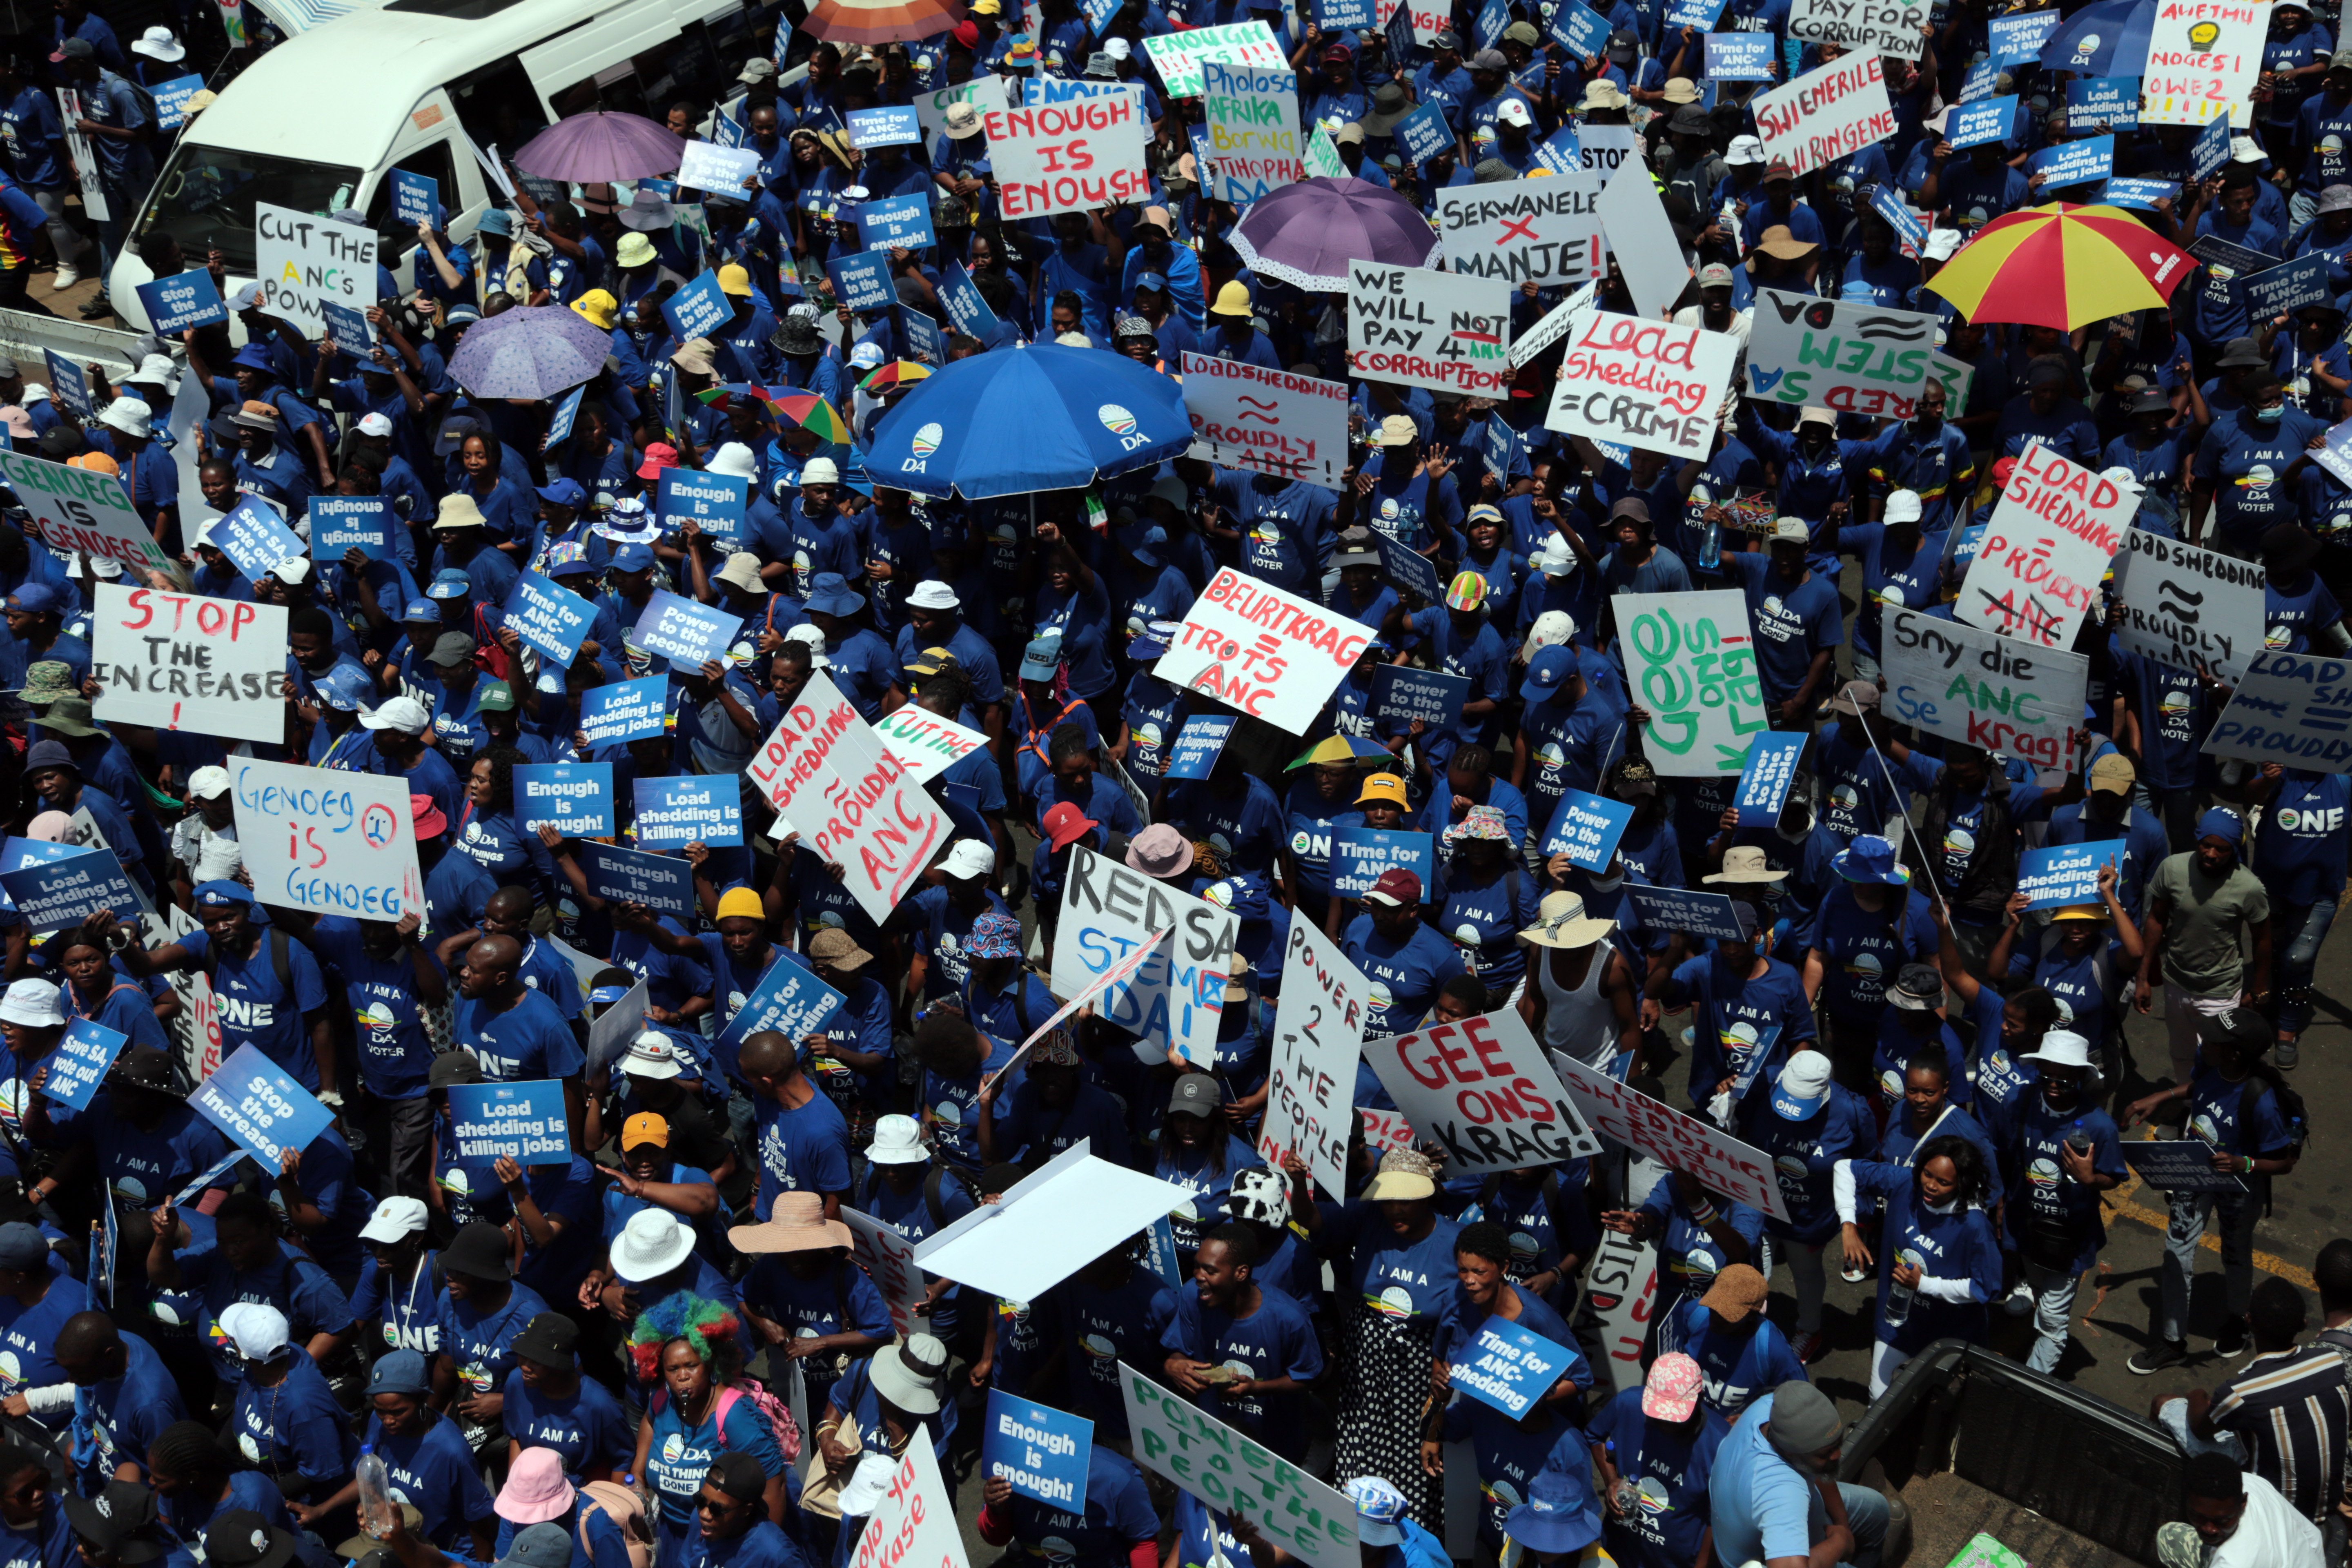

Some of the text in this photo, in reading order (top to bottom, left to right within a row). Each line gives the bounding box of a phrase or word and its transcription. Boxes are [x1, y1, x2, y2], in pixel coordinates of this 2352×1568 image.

[1147, 22, 1268, 55] ENOUGH
[2070, 54, 2089, 65] DA
[852, 113, 909, 127] Time for
[984, 99, 1131, 141] ENOUGH
[1207, 96, 1283, 127] AFRIKA
[1958, 118, 1998, 134] to the
[1960, 107, 2002, 125] Power
[854, 130, 916, 146] shedding
[866, 122, 901, 134] ANC-
[1951, 127, 2002, 148] people!
[699, 152, 742, 170] Power
[1036, 139, 1094, 172] IS
[689, 175, 742, 193] people!
[696, 165, 738, 181] to the
[1001, 168, 1149, 216] ENOUGH
[1443, 191, 1600, 230] SEKWANELE
[259, 213, 375, 263] CUT THE
[1454, 234, 1600, 278] MANJE!
[2154, 253, 2180, 284] SHOPRITE
[162, 285, 195, 303] Stop
[1354, 268, 1405, 294] WE
[156, 304, 222, 331] increase!
[171, 299, 196, 313] the
[1354, 296, 1507, 336] WILL NOT
[1364, 322, 1505, 361] PAY 4 ANC
[1799, 330, 1929, 383] STEM
[1354, 350, 1507, 391] CORRUPTION
[1823, 385, 1915, 420] RED
[1120, 432, 1152, 451] DA
[1189, 413, 1315, 461] PROUDLY
[901, 458, 926, 474] DA
[2255, 451, 2272, 460] AM
[2276, 451, 2284, 460] A
[1, 451, 134, 513] GENOEG
[2020, 444, 2119, 508] LOAD
[318, 501, 384, 516] enough!
[2237, 501, 2274, 512] VOTER
[2246, 490, 2270, 501] DA
[54, 498, 97, 526] IS
[345, 517, 359, 529] is
[2006, 478, 2119, 558] SHEDDING
[322, 532, 384, 546] Enough
[1980, 535, 2094, 612] PROUDLY
[121, 588, 255, 641] STOP
[520, 583, 583, 628] Time for
[523, 604, 564, 633] ANC-
[1205, 570, 1367, 667] BEURTKRAG
[1781, 610, 1800, 624] DA
[503, 613, 571, 662] shedding
[1762, 626, 1786, 639] DONE
[1773, 621, 1805, 636] THINGS
[2120, 607, 2232, 661] PROUDLY
[143, 635, 212, 669] THE
[1029, 652, 1049, 664] UZZI
[1180, 622, 1288, 682] TROTS
[1894, 613, 2036, 680] Sny die
[93, 662, 285, 701] INCREASE
[1189, 662, 1276, 717] ANC
[1896, 685, 1942, 725] Se
[1945, 674, 2046, 725] ANC
[753, 705, 815, 782] LOAD
[773, 702, 855, 808] SHEDDING
[527, 780, 599, 798] Enough
[666, 791, 710, 806] Load
[815, 747, 906, 860] PROUDLY
[556, 798, 571, 813] is
[638, 806, 739, 824] shedding is
[2277, 807, 2343, 831] ONE
[526, 815, 603, 834] enough!
[642, 822, 738, 841] killing jobs
[860, 790, 925, 891] ANC
[1069, 847, 1234, 963] RED SA
[1289, 927, 1360, 1033] POWER
[372, 1032, 396, 1044] DA
[1302, 1004, 1321, 1048] 2
[62, 1035, 107, 1065] Save SA,
[367, 1044, 404, 1057] VOTER
[1396, 1018, 1516, 1090] GEE
[52, 1056, 98, 1084] vote out
[1283, 1034, 1335, 1109] THE
[49, 1076, 79, 1098] ANC
[248, 1077, 294, 1118] Stop
[1457, 1078, 1556, 1125] ONS
[241, 1096, 274, 1128] the
[483, 1100, 531, 1118] Load
[1272, 1068, 1345, 1172] PEOPLE
[1776, 1100, 1802, 1116] ONE
[200, 1088, 282, 1163] increase!
[455, 1117, 564, 1138] shedding is
[1432, 1100, 1592, 1167] KRAG!
[460, 1136, 564, 1157] killing jobs
[1476, 1354, 1523, 1382] ANC-
[1477, 1331, 1551, 1374] Time for
[1450, 1363, 1528, 1411] shedding
[999, 1414, 1075, 1456] Enough
[1133, 1377, 1308, 1498] POWER
[649, 1459, 670, 1476] GETS
[683, 1448, 712, 1461] DA
[1026, 1446, 1042, 1468] is
[664, 1479, 693, 1493] DONE
[992, 1461, 1073, 1502] enough!
[1142, 1428, 1319, 1556] PEOPLE
[1167, 1423, 1358, 1548] TO THE
